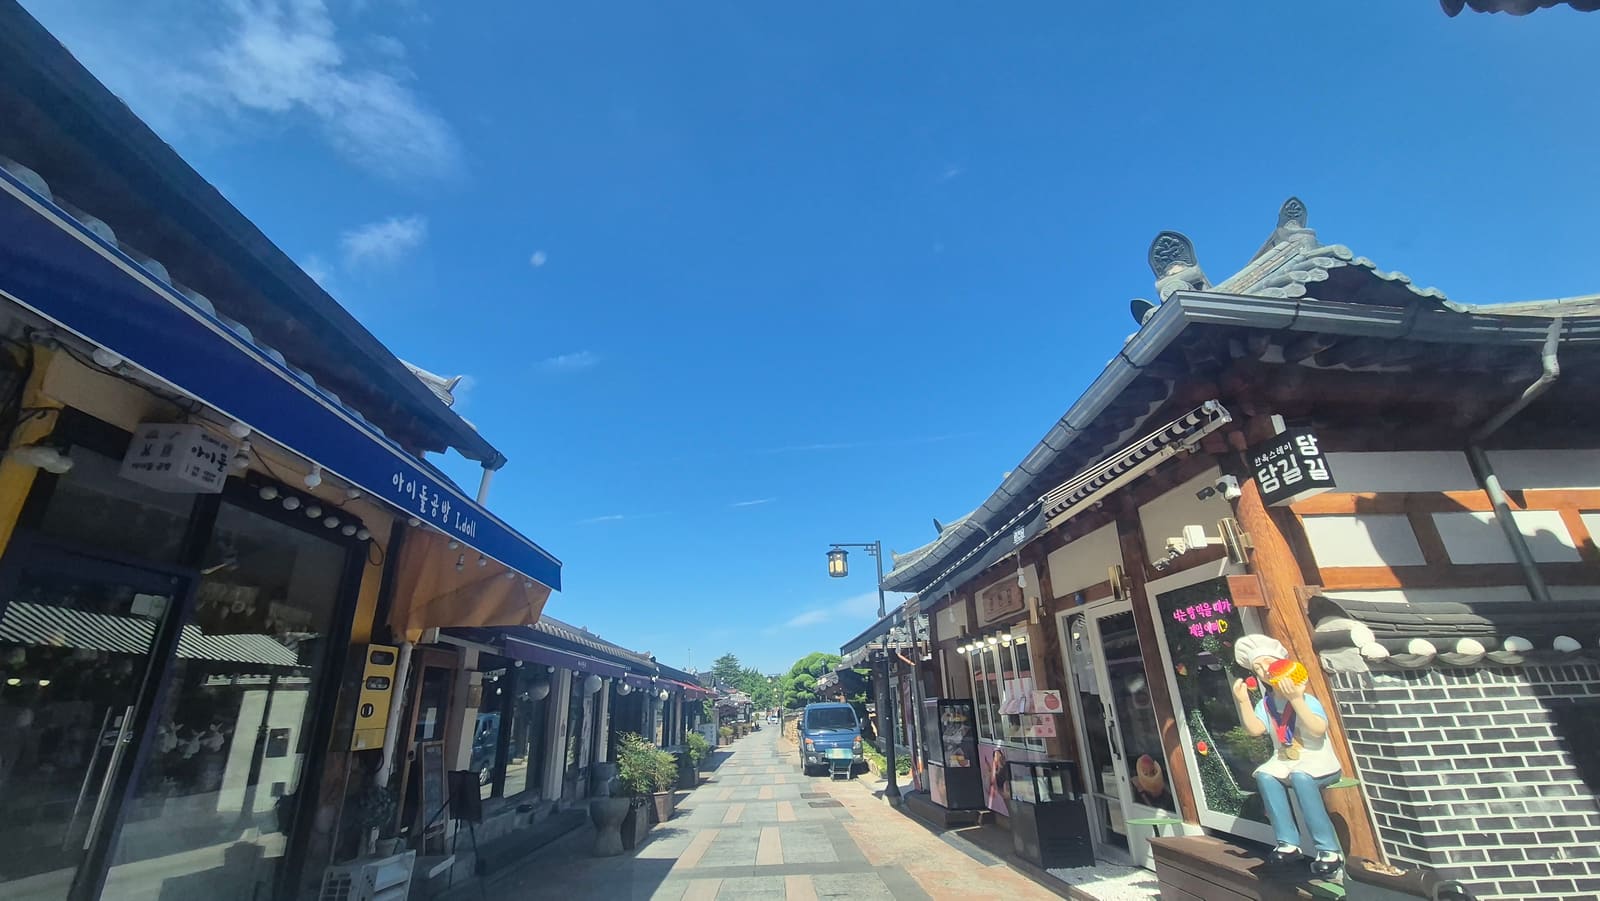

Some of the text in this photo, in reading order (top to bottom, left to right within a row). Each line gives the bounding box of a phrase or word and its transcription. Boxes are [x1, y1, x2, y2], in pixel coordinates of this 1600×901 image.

[191, 445, 228, 473] 아이돌
[1257, 453, 1303, 494] 담길
[392, 471, 451, 524] 아이돌공방
[1195, 602, 1212, 618] 먹을
